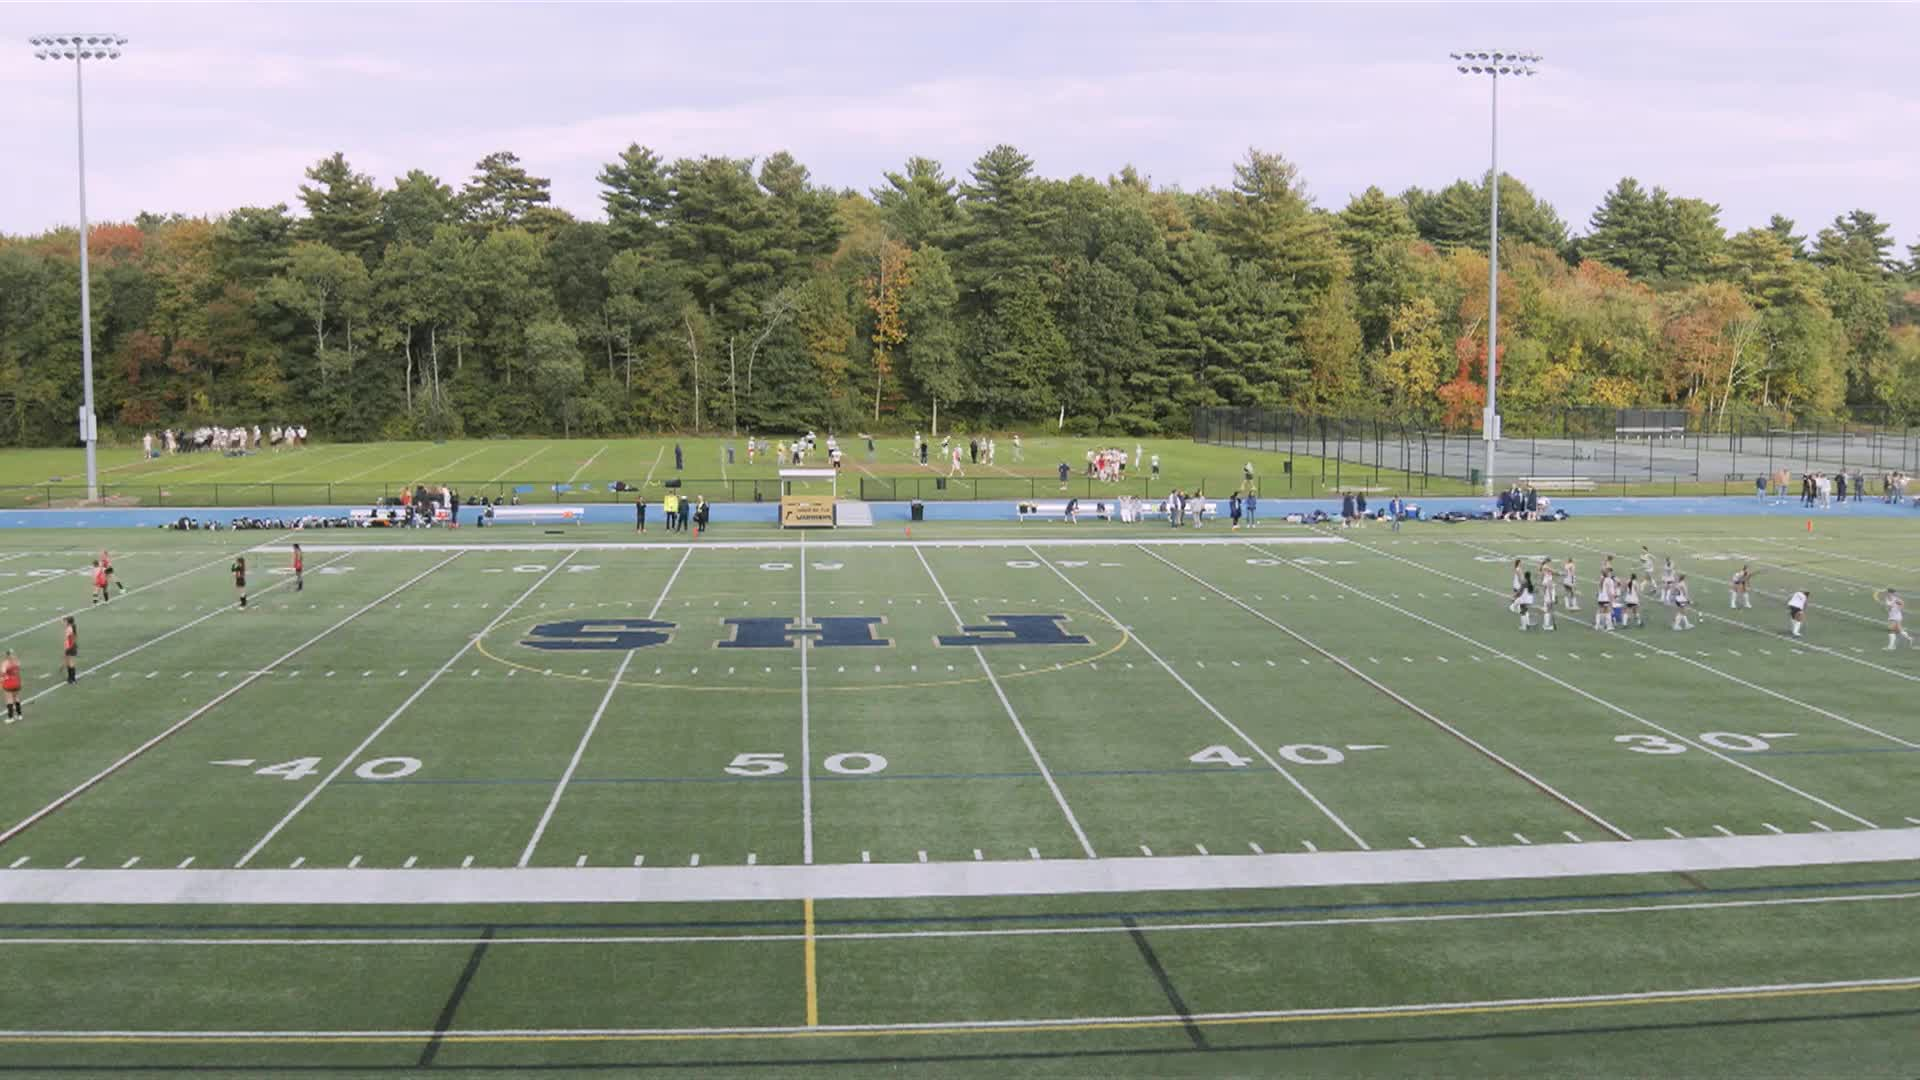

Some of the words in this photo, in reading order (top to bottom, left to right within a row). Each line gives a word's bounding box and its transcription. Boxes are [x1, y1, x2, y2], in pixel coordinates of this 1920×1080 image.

[1189, 743, 1345, 767] 40
[1613, 731, 1771, 755] 30
[253, 756, 423, 781] 40
[724, 752, 888, 777] 50
